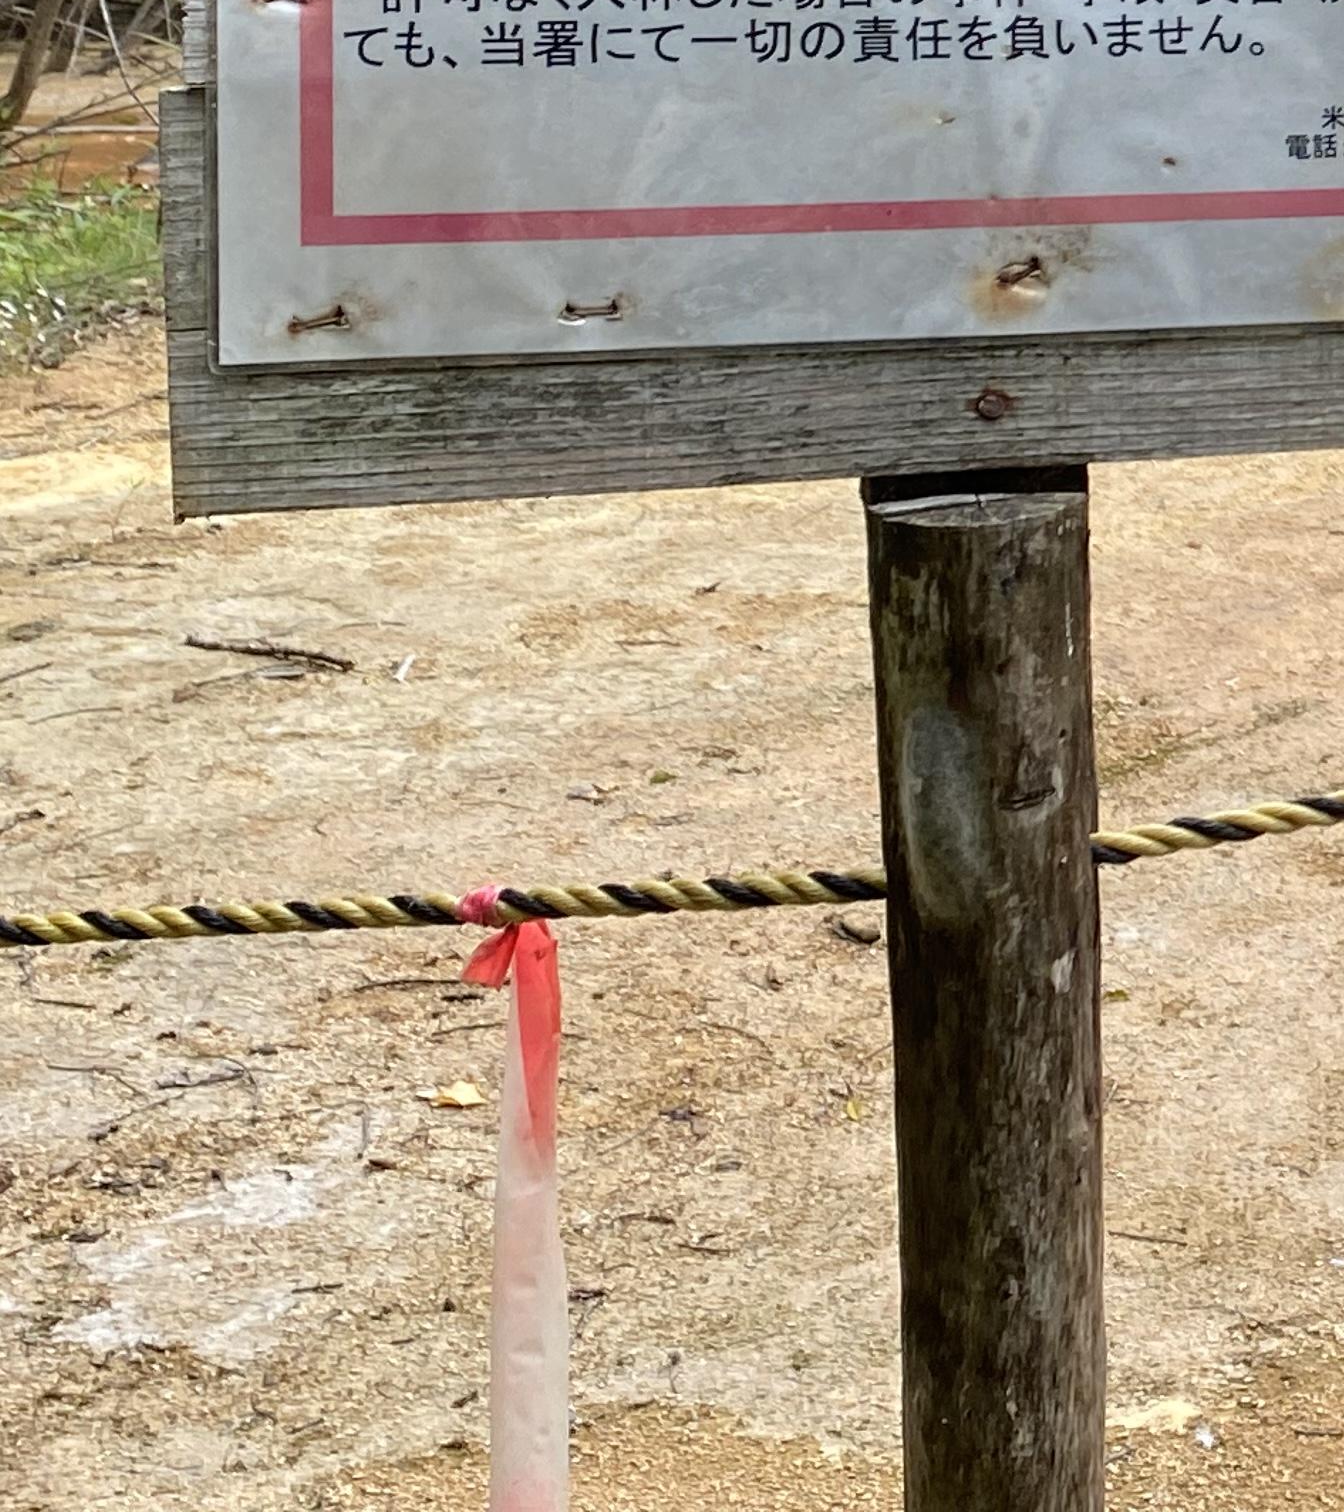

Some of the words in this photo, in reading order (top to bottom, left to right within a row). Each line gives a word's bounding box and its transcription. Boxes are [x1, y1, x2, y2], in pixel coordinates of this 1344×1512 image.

[342, 13, 1266, 70] ても、当署にて一切の責任を負いません。
